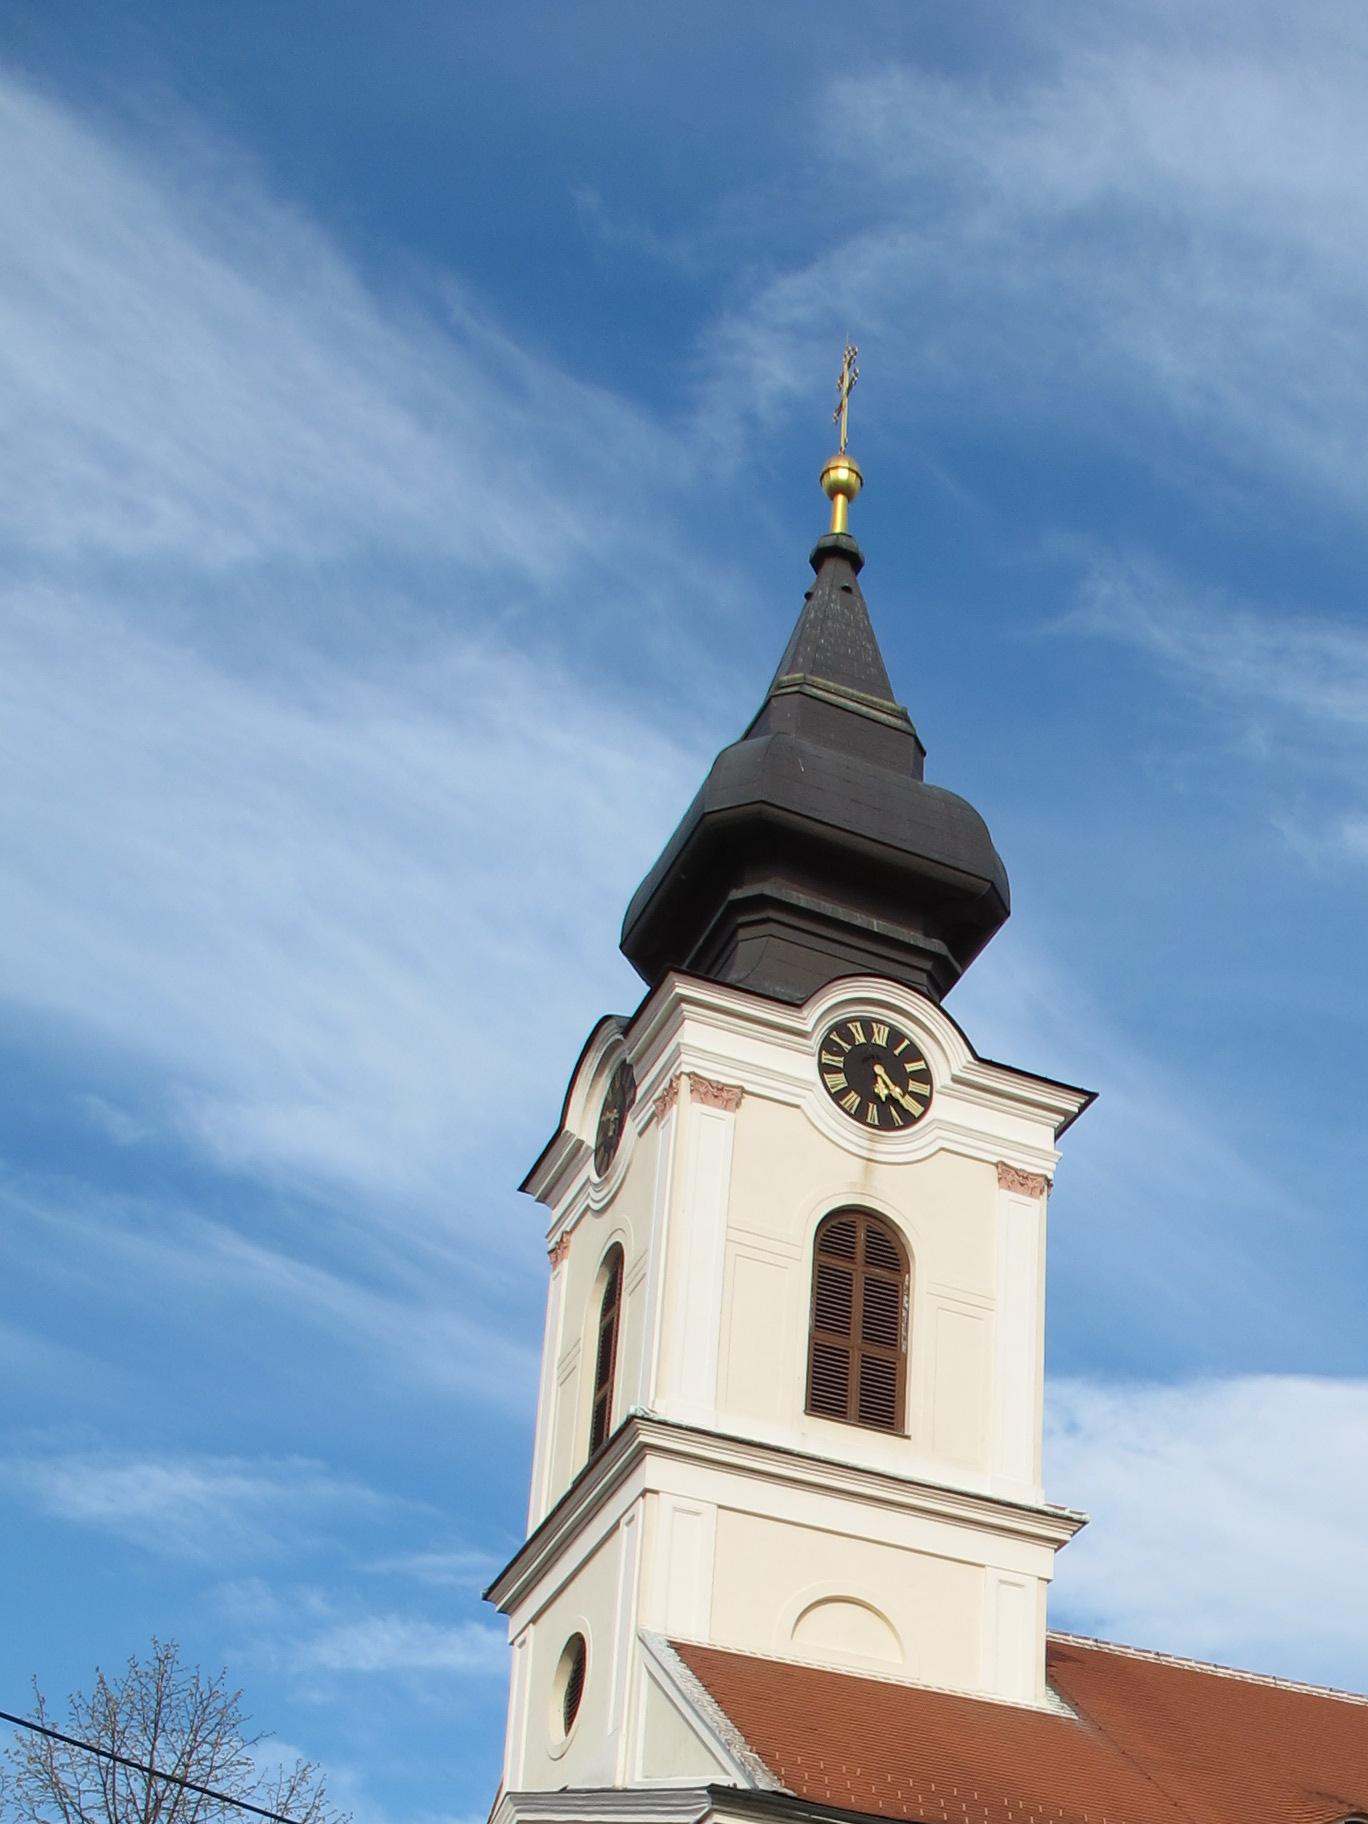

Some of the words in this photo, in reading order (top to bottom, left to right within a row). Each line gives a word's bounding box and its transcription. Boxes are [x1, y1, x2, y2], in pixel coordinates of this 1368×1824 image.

[830, 1032, 852, 1053] X
[847, 1021, 867, 1044] XI
[871, 1022, 890, 1047] XII
[893, 1039, 910, 1056] I
[821, 1050, 845, 1068] IX
[904, 1060, 927, 1072] II
[908, 1079, 930, 1096] III
[839, 1090, 861, 1114] VII
[866, 1103, 880, 1125] VI
[889, 1105, 903, 1126] V
